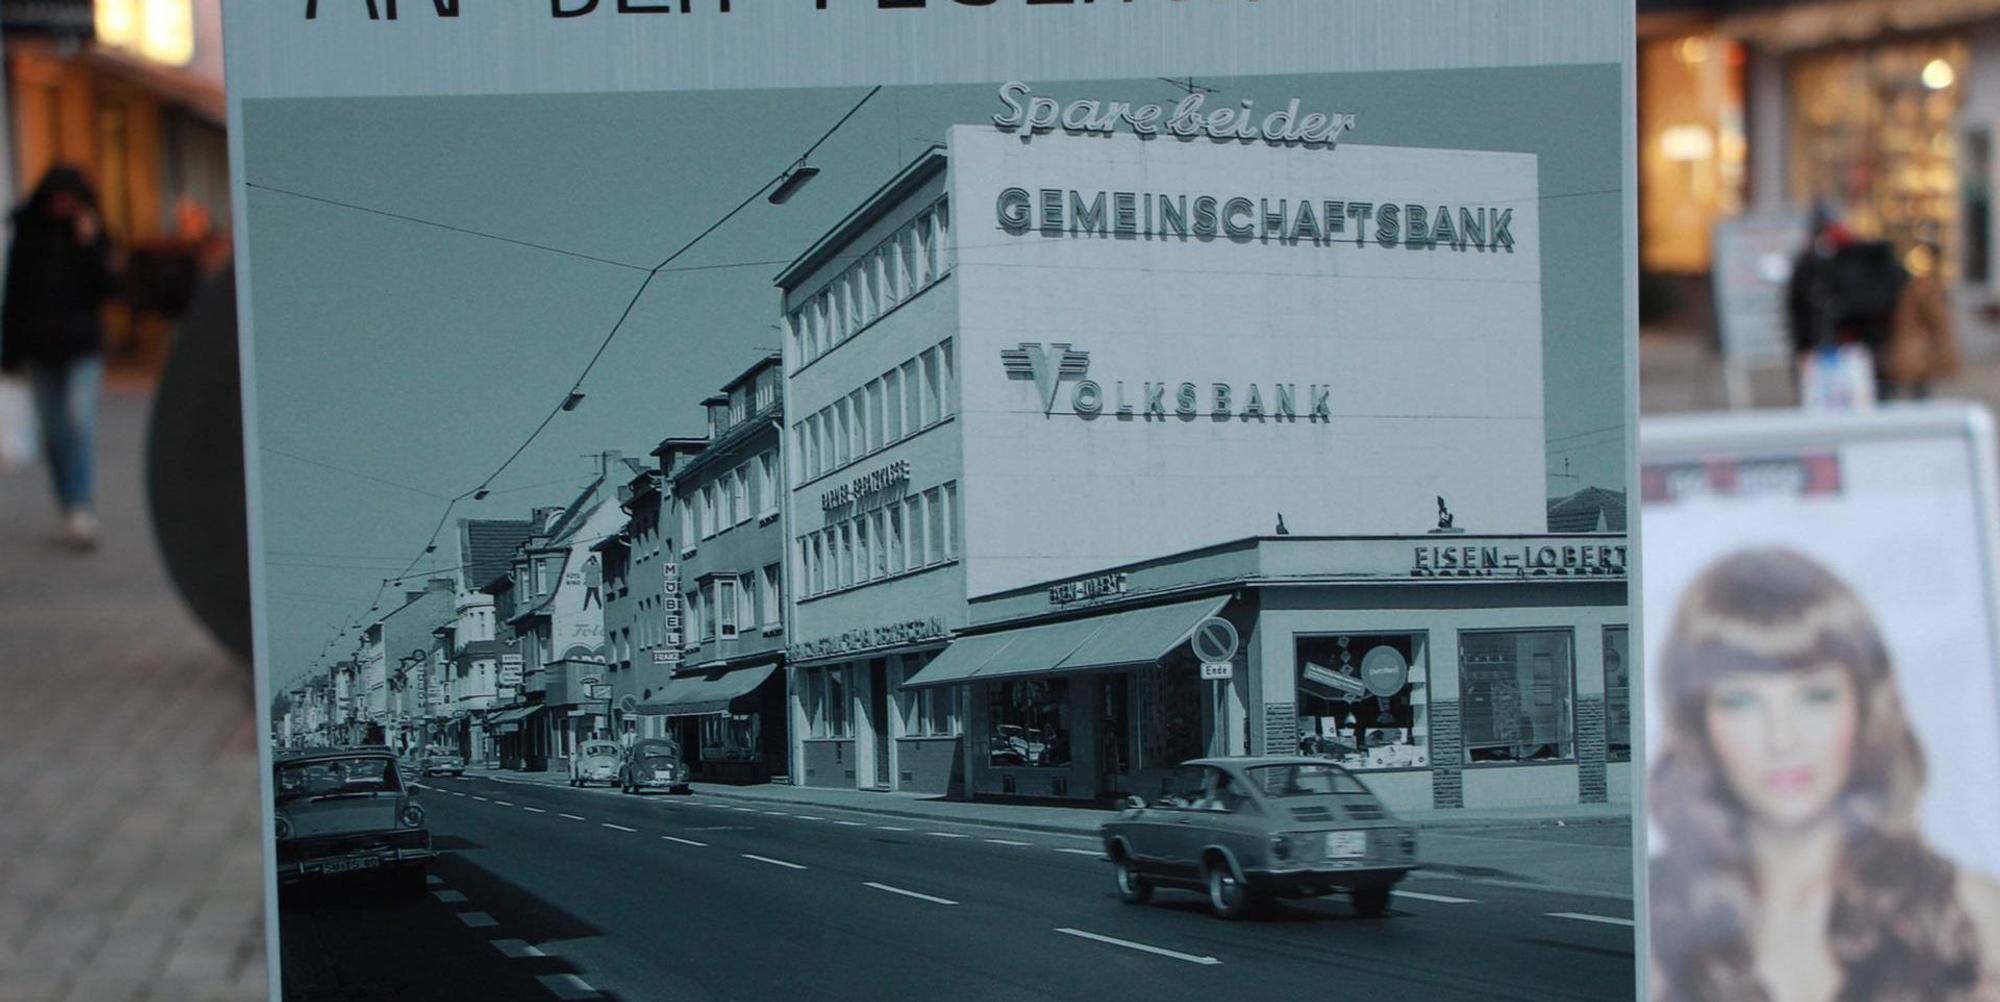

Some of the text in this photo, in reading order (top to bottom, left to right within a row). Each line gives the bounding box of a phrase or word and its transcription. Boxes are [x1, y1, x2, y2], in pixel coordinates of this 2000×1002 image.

[992, 81, 1355, 144] Spare bei der
[995, 186, 1515, 250] GEMEINSCHAFTSBANK
[1001, 342, 1332, 422] VOLKSBANK
[1206, 665, 1228, 675] Ende
